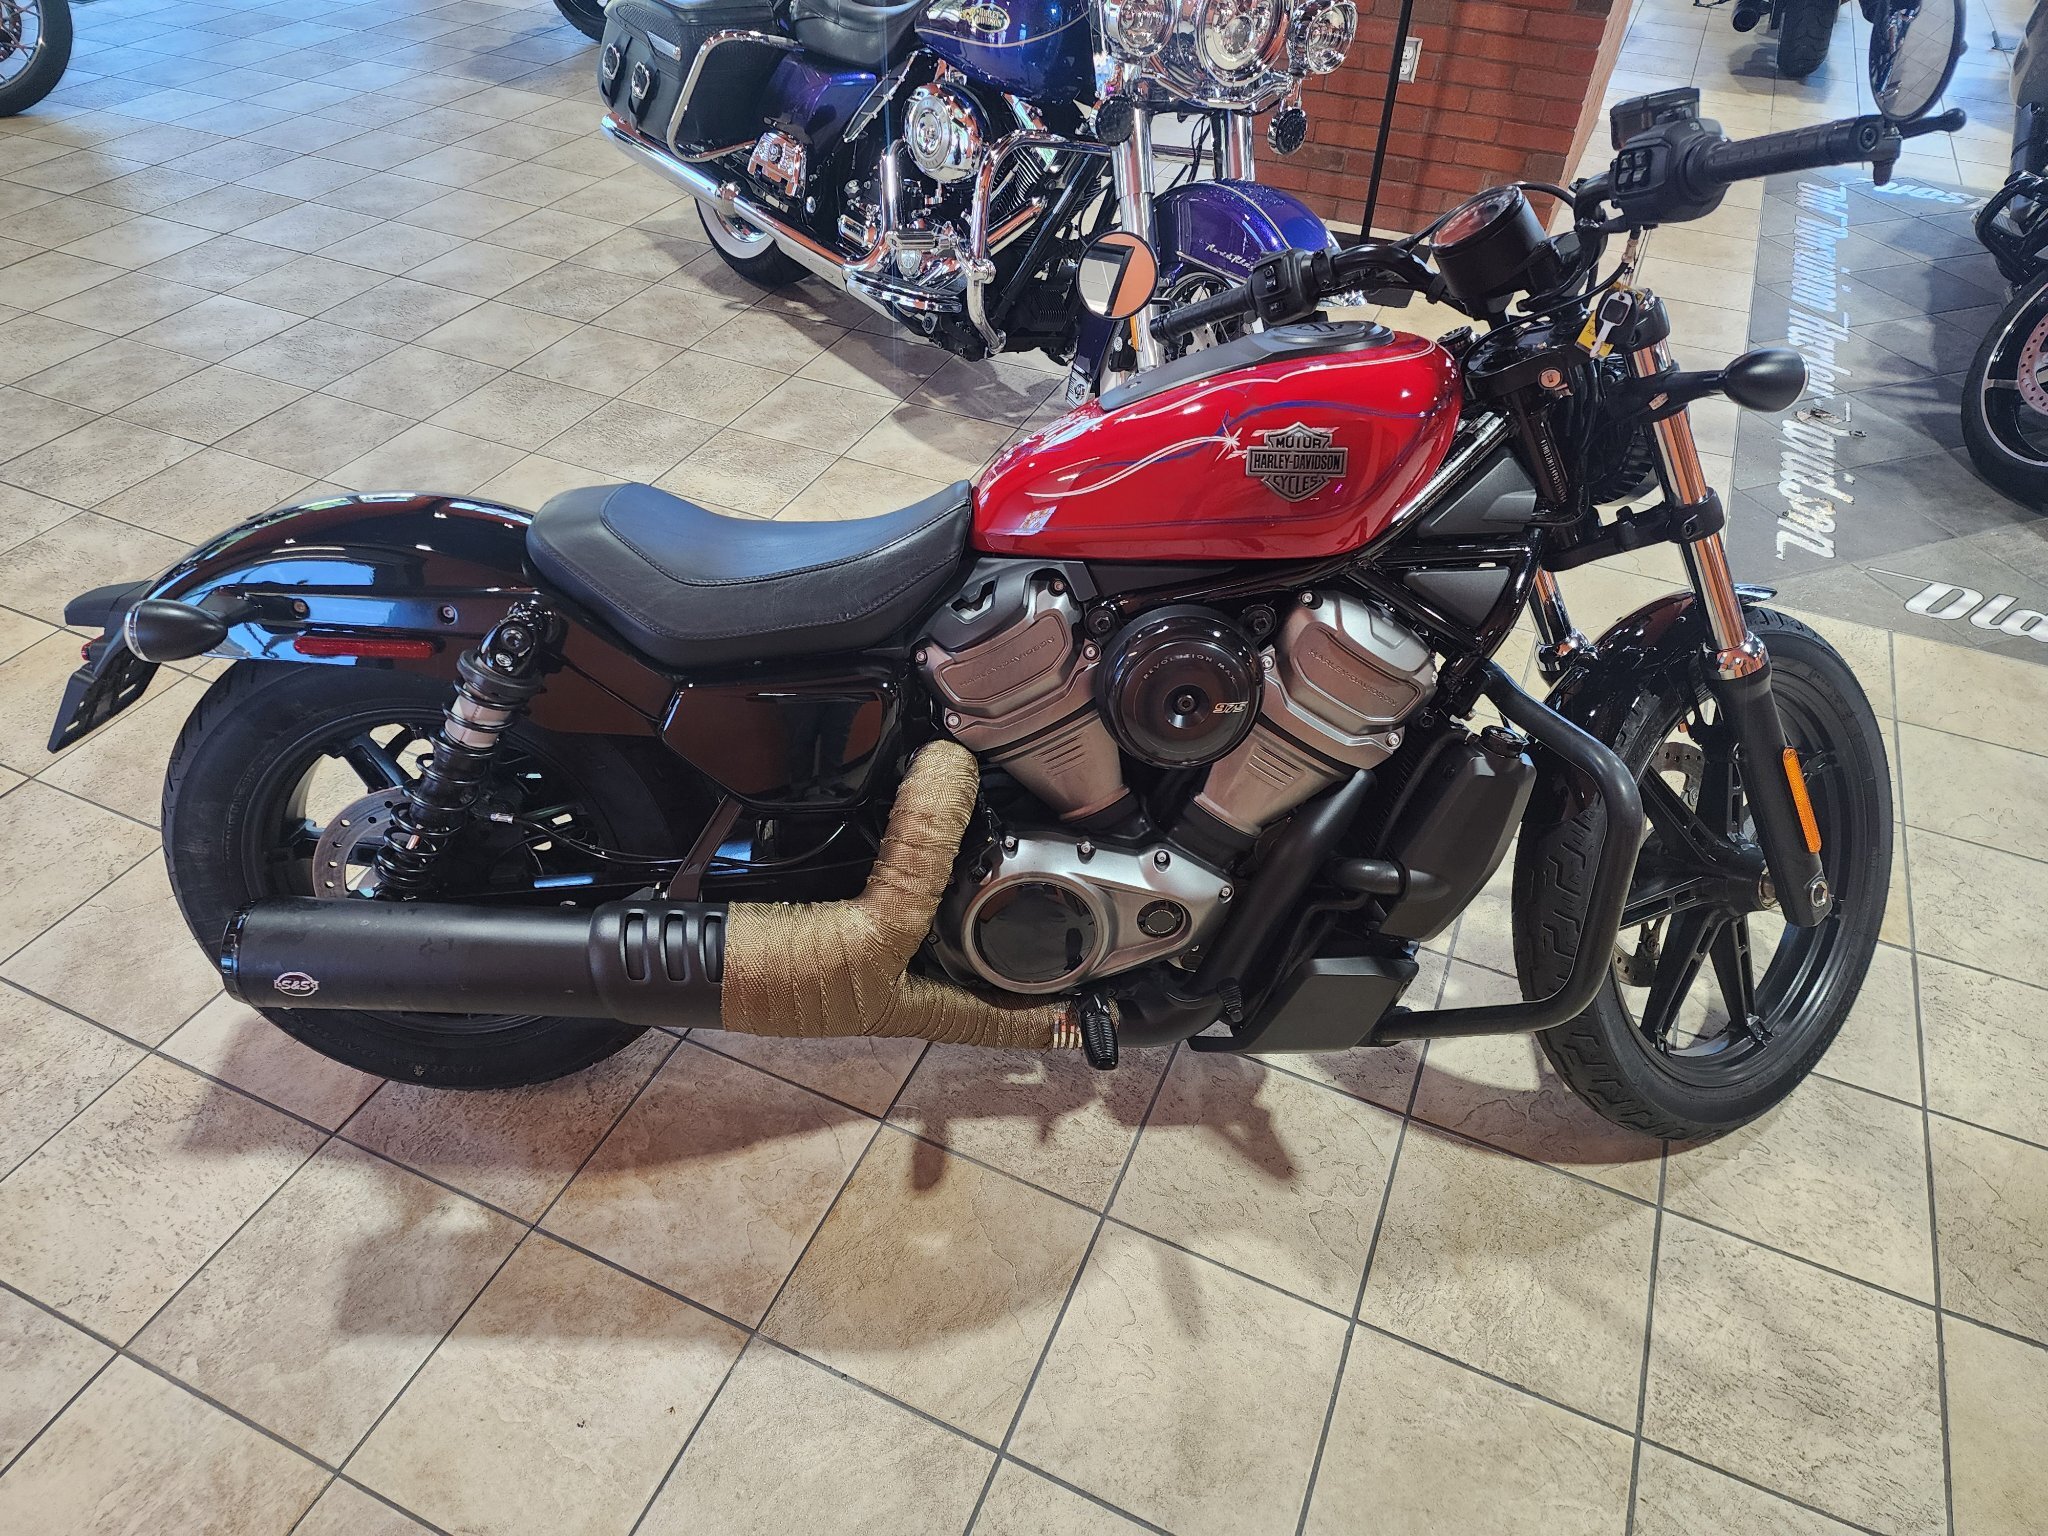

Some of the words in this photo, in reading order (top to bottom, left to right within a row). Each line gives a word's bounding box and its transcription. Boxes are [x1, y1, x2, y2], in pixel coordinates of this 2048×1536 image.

[1791, 214, 1852, 312] Dominion
[1276, 433, 1322, 449] MOTOR
[1253, 453, 1340, 471] HARLEY-DAVIDSON
[1273, 474, 1319, 494] CYCLES
[1212, 700, 1249, 714] 975
[281, 979, 311, 991] S&S
